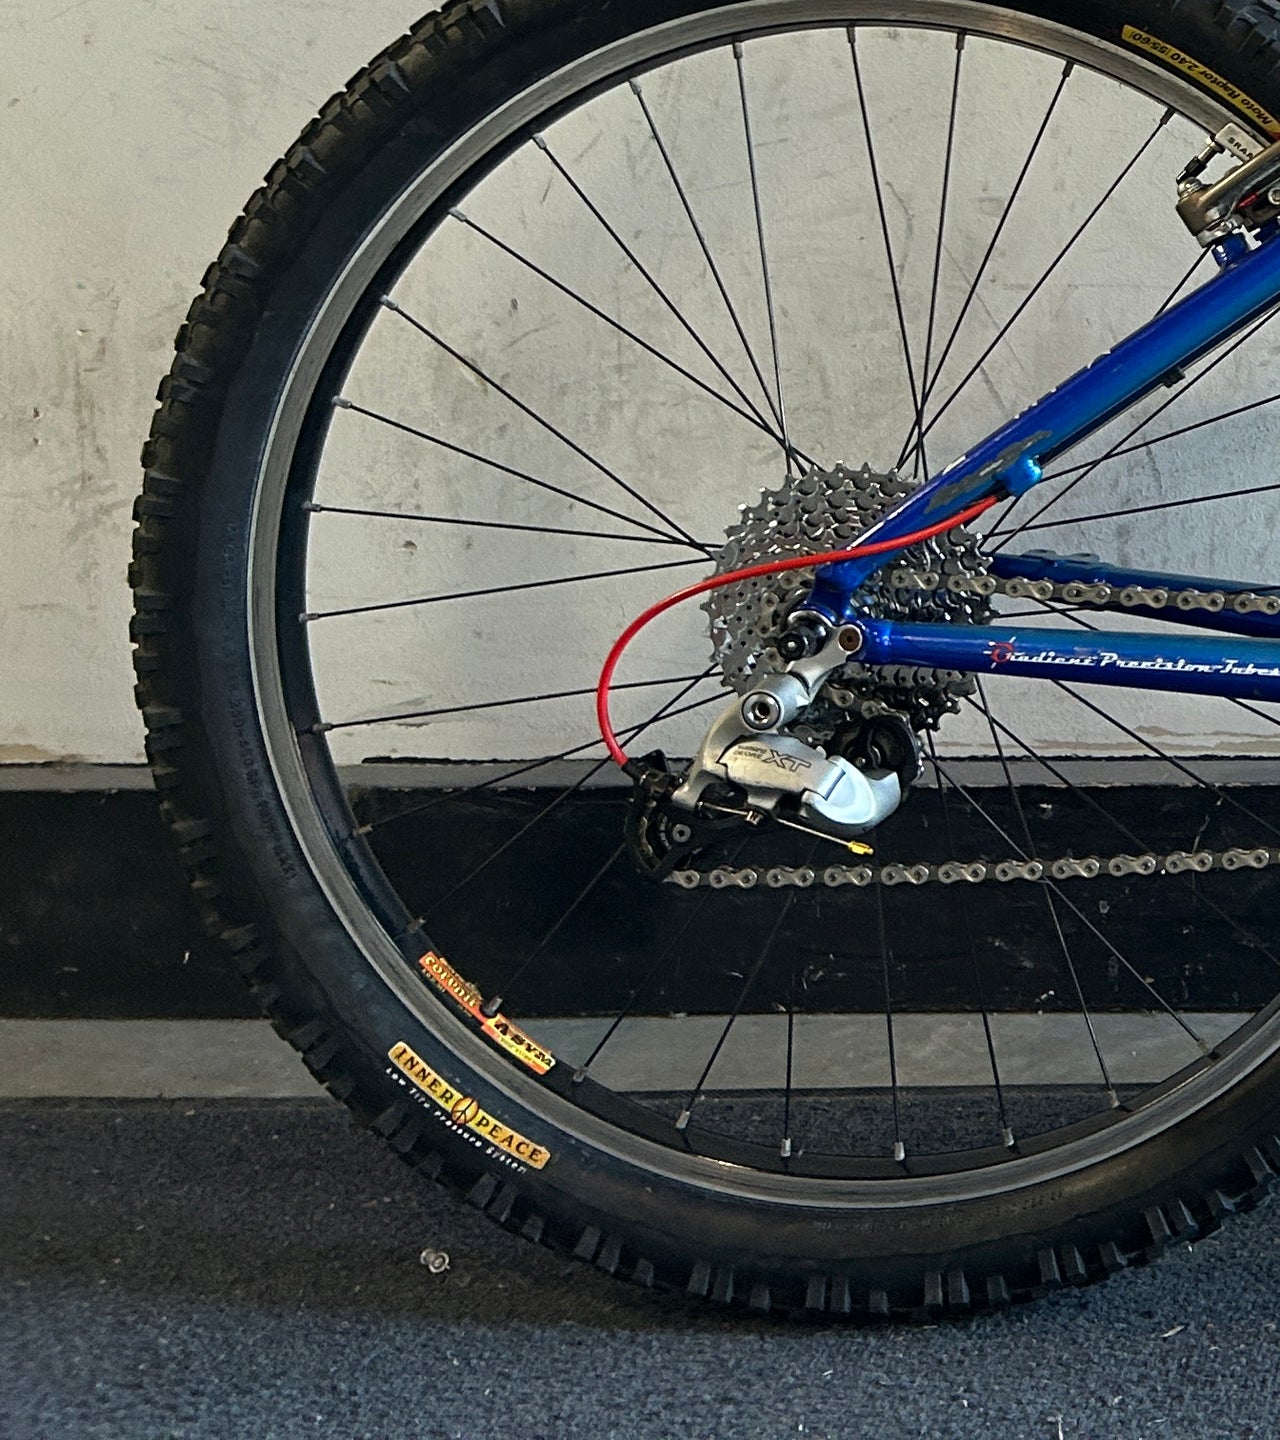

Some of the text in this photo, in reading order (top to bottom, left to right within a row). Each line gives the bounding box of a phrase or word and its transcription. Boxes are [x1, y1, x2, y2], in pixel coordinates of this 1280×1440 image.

[1199, 67, 1242, 101] Raptor
[1241, 96, 1273, 126] Moto
[762, 749, 812, 773] XT
[394, 1047, 455, 1106] INNER
[475, 1116, 543, 1164] PEACE
